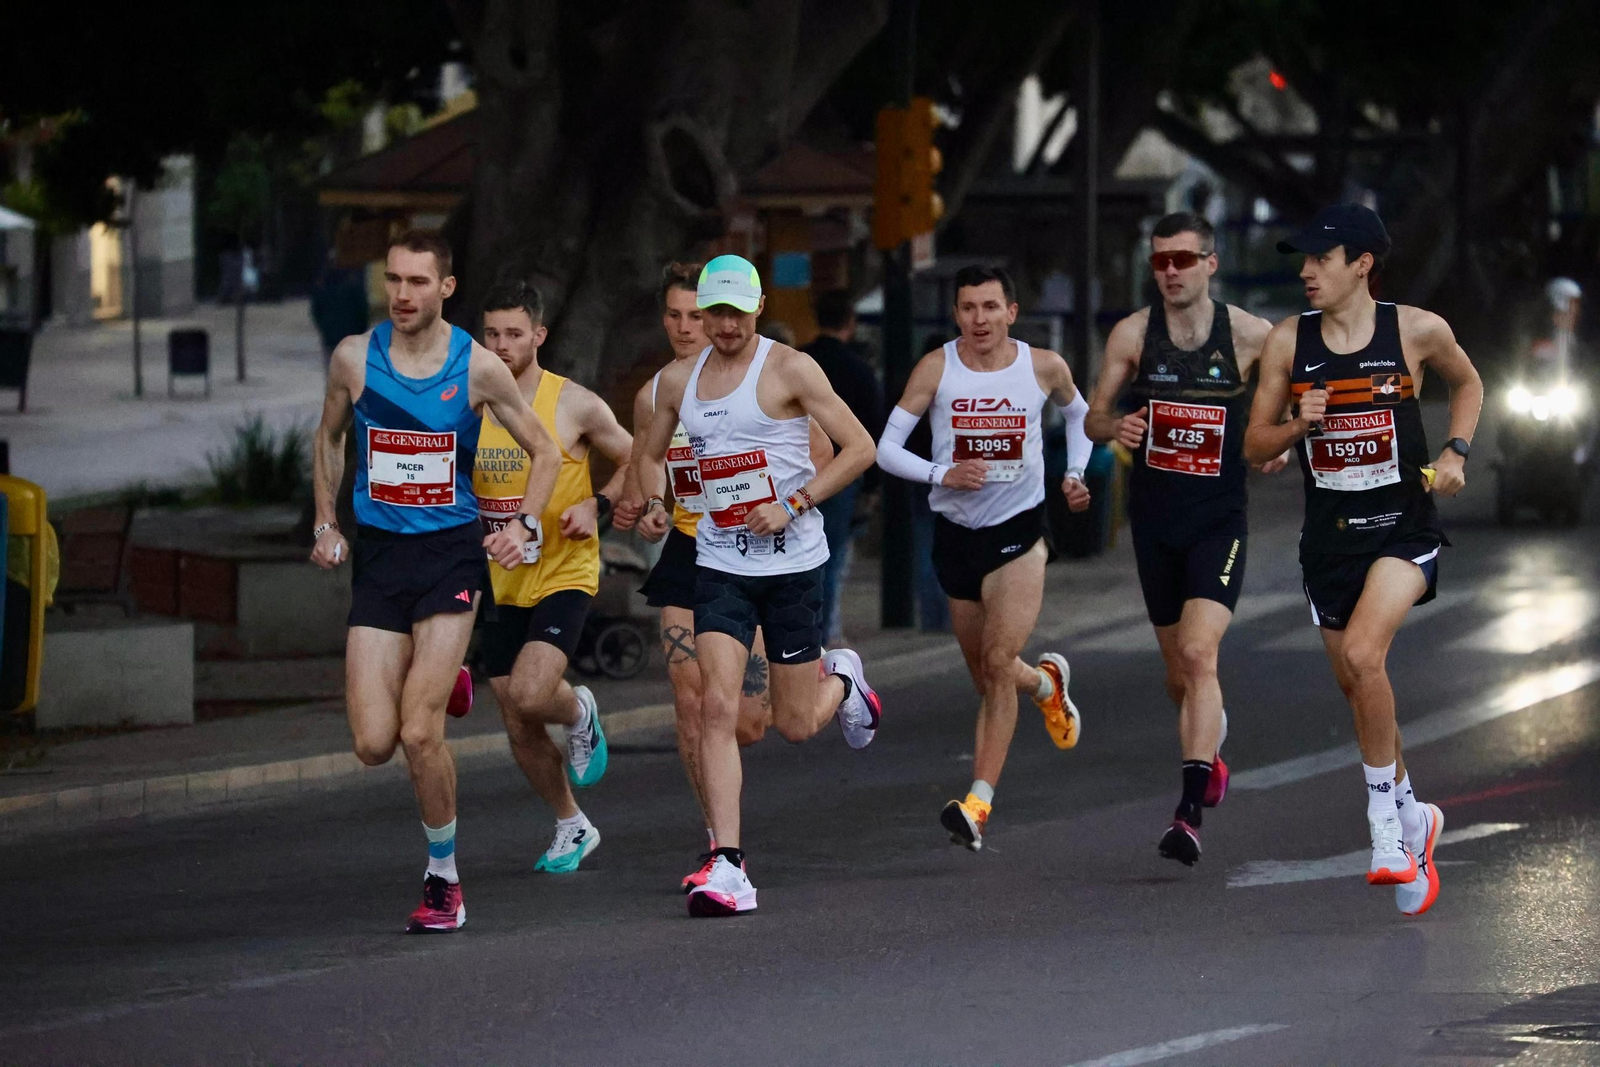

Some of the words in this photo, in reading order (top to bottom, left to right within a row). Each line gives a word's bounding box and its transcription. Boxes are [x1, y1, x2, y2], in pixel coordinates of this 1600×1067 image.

[951, 398, 1012, 412] GIZA
[704, 410, 723, 418] CRAFT
[1170, 406, 1221, 421] GENERALI
[971, 417, 1021, 428] GENERALI
[391, 434, 449, 448] GENERALI
[1167, 428, 1205, 444] 4735
[966, 439, 1011, 452] 13095
[1325, 440, 1378, 457] 15970
[396, 462, 424, 471] PACER
[711, 453, 761, 471] GENERALI
[482, 472, 489, 483] &
[1371, 468, 1385, 476] 21K
[716, 482, 751, 495] COLLARD
